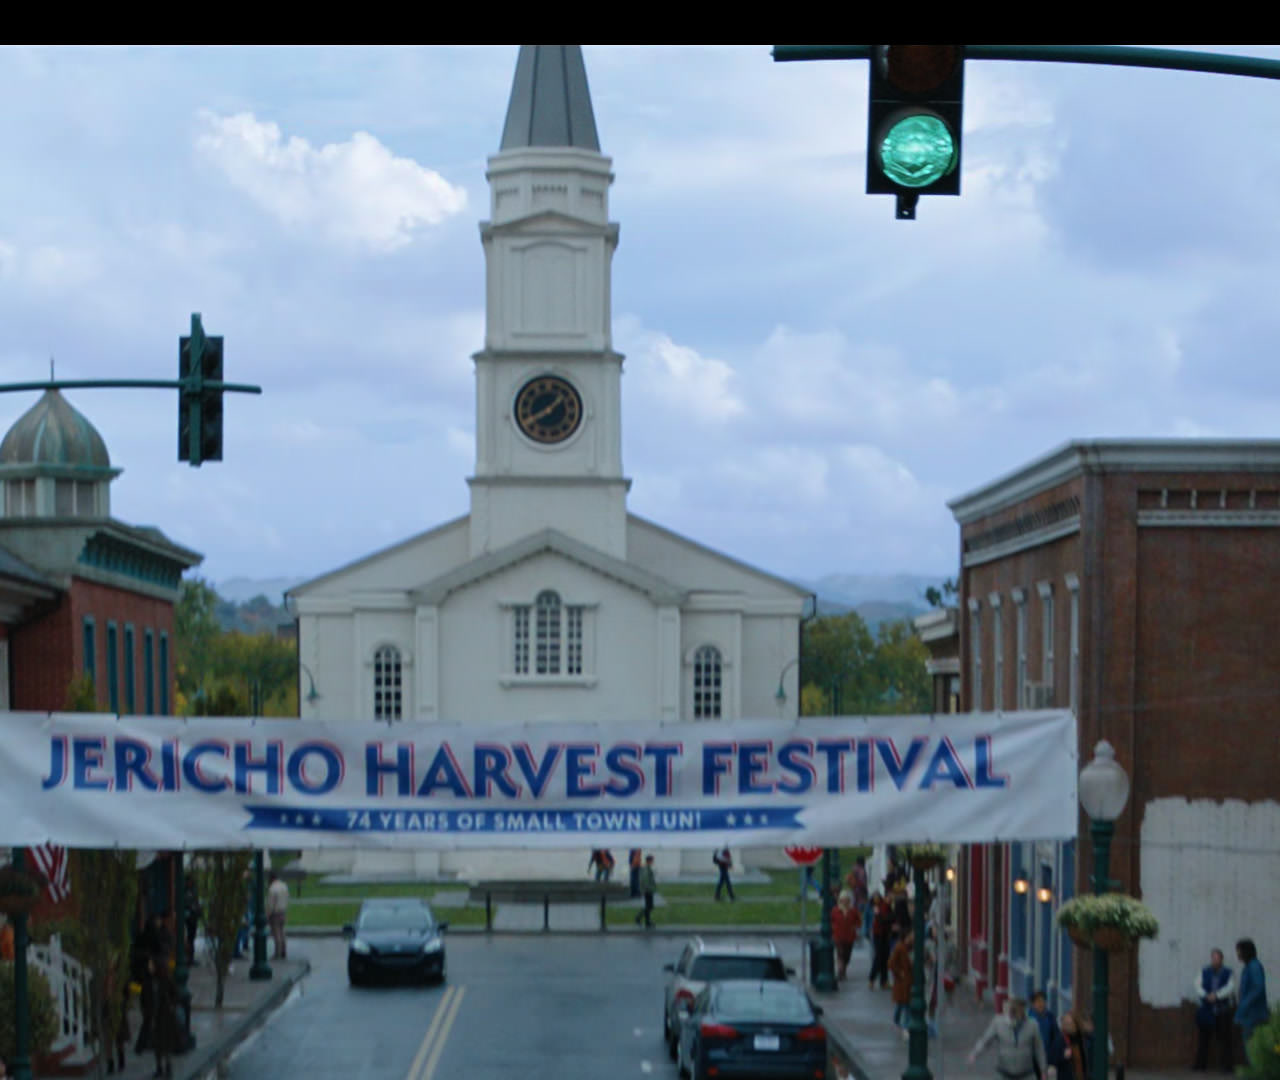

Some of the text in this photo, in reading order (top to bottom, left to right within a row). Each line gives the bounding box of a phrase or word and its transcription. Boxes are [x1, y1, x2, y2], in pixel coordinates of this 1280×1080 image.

[41, 733, 1010, 800] JERICHO HARVEST FESTIVAL
[347, 810, 701, 831] 74 YEARS OF SMALL TOWN FUN!
